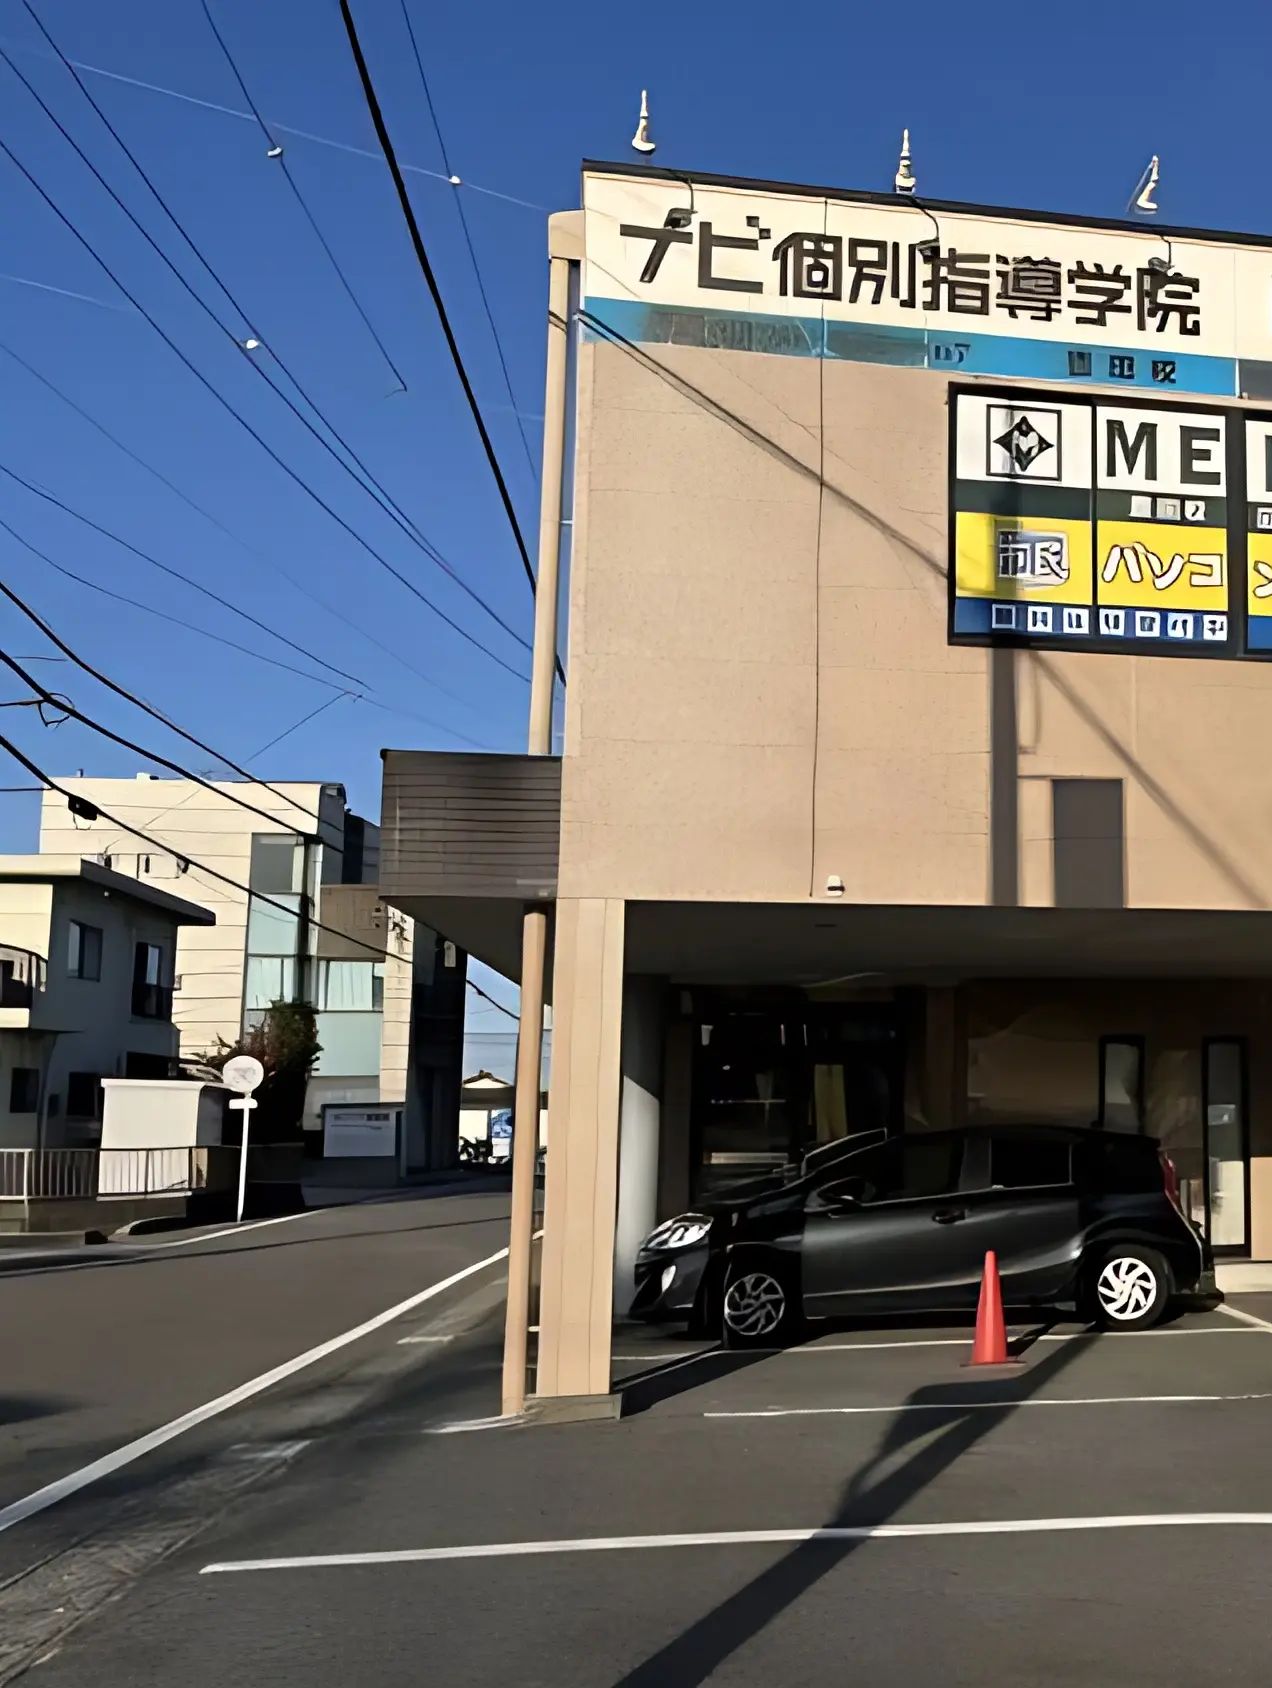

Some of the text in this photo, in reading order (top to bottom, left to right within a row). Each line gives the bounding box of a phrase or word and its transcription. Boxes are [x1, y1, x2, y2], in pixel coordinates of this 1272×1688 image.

[620, 216, 1201, 336] ナビ個別指導学院
